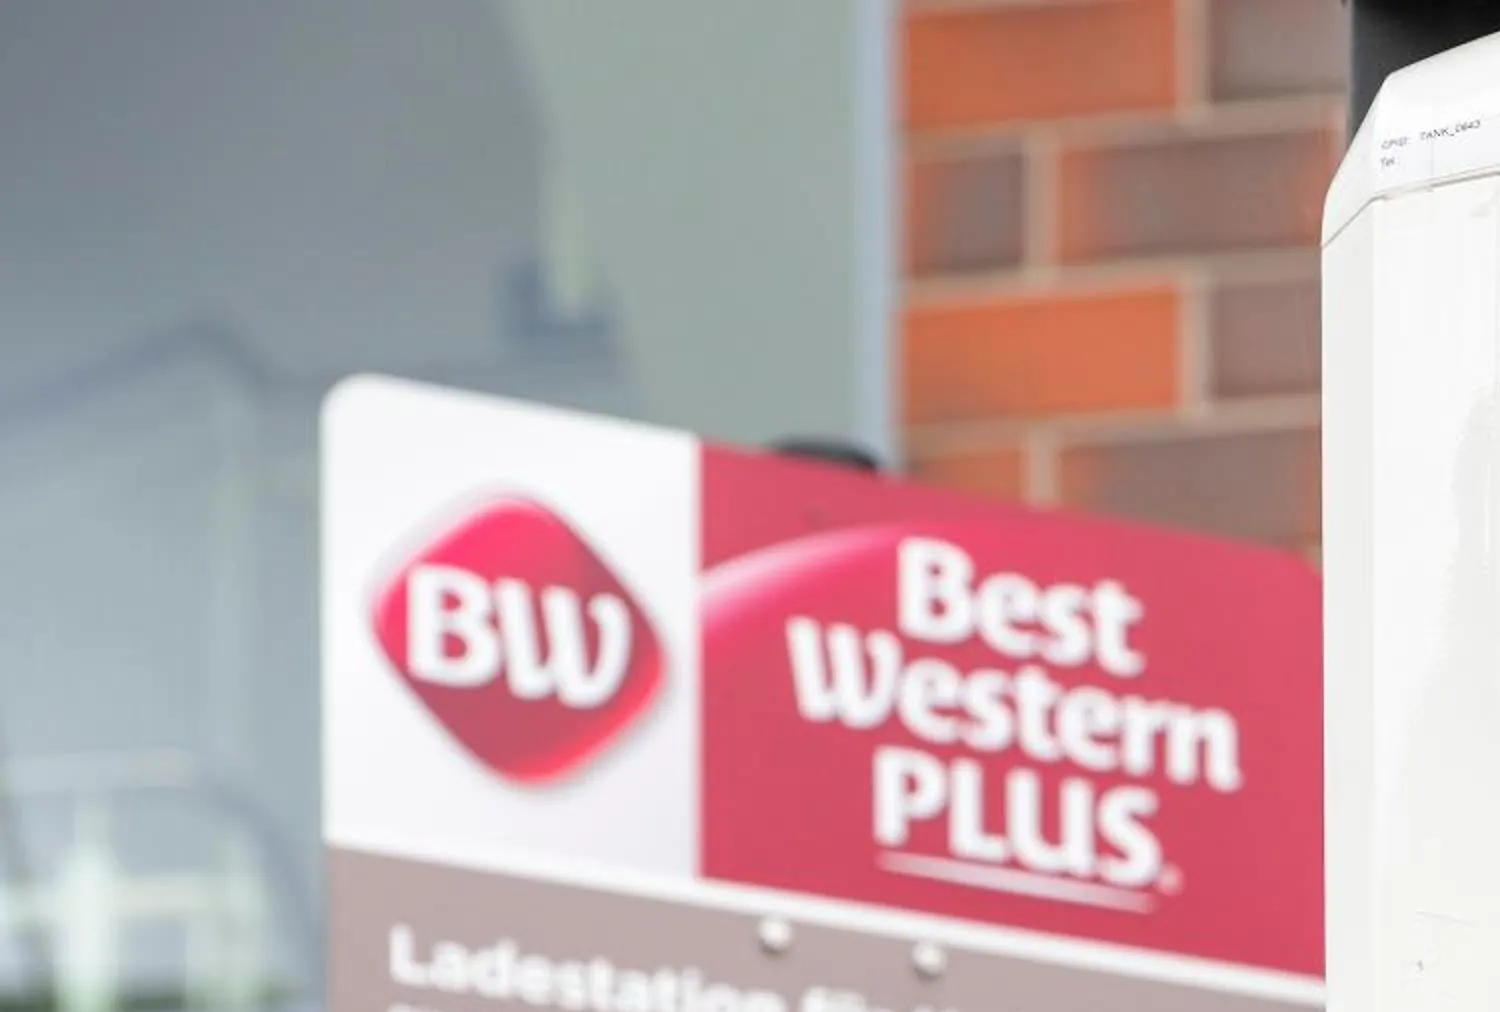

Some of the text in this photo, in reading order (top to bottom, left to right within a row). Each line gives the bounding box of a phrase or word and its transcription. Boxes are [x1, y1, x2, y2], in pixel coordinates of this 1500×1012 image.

[406, 563, 633, 708] BW
[897, 536, 1146, 678] Best
[786, 614, 1242, 790] Western
[873, 746, 1163, 888] PLUS
